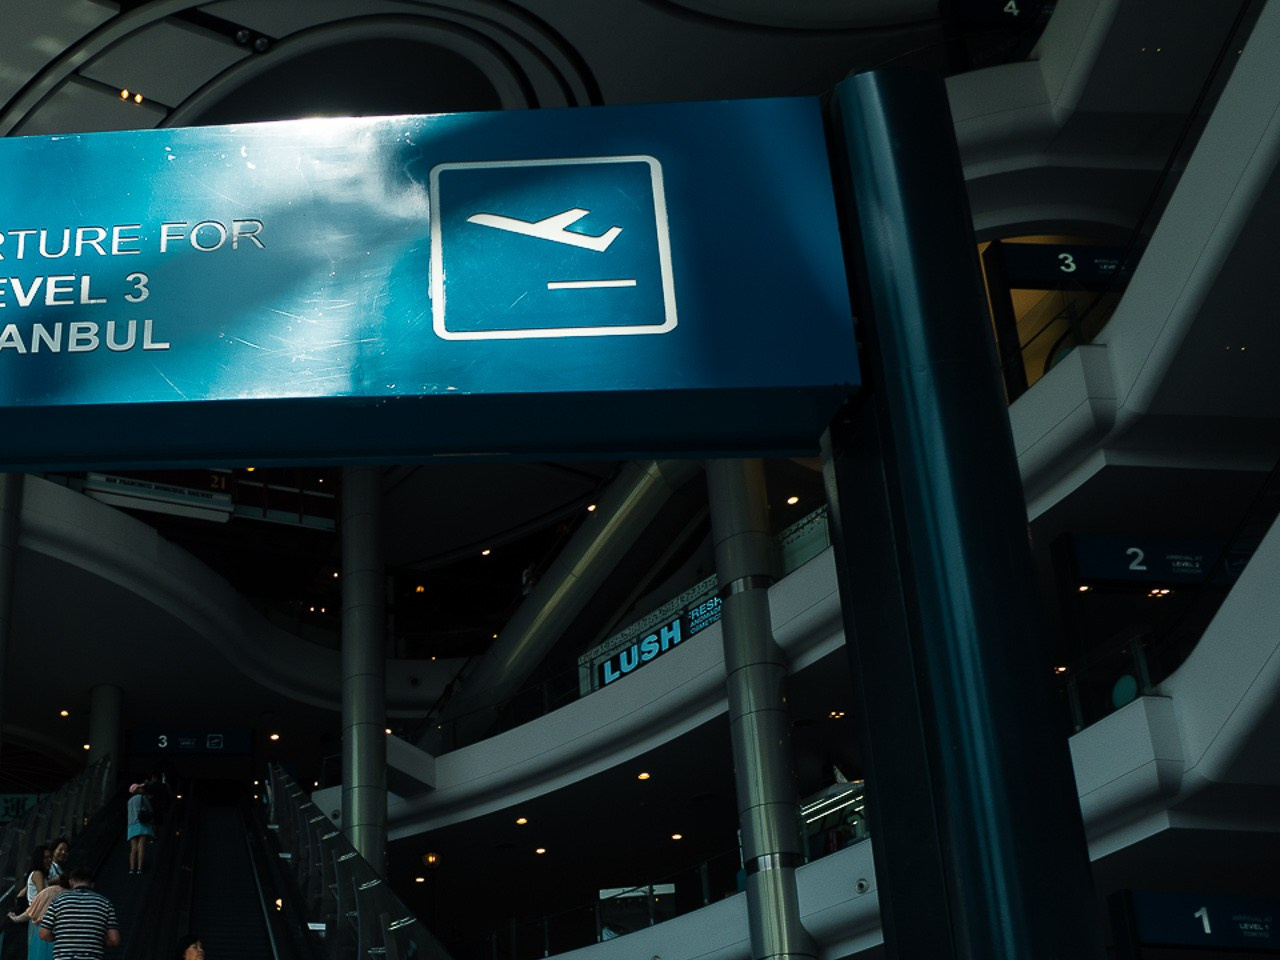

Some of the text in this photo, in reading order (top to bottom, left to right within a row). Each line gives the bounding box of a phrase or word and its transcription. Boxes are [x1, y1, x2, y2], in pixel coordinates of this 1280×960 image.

[1003, 0, 1021, 16] 4
[159, 218, 267, 253] FOR
[1057, 252, 1077, 273] 3
[123, 272, 151, 303] 3
[1125, 547, 1148, 571] 2
[688, 596, 723, 621] RESH
[603, 619, 682, 686] LUSH
[157, 734, 168, 748] 3
[1193, 906, 1212, 934] 1
